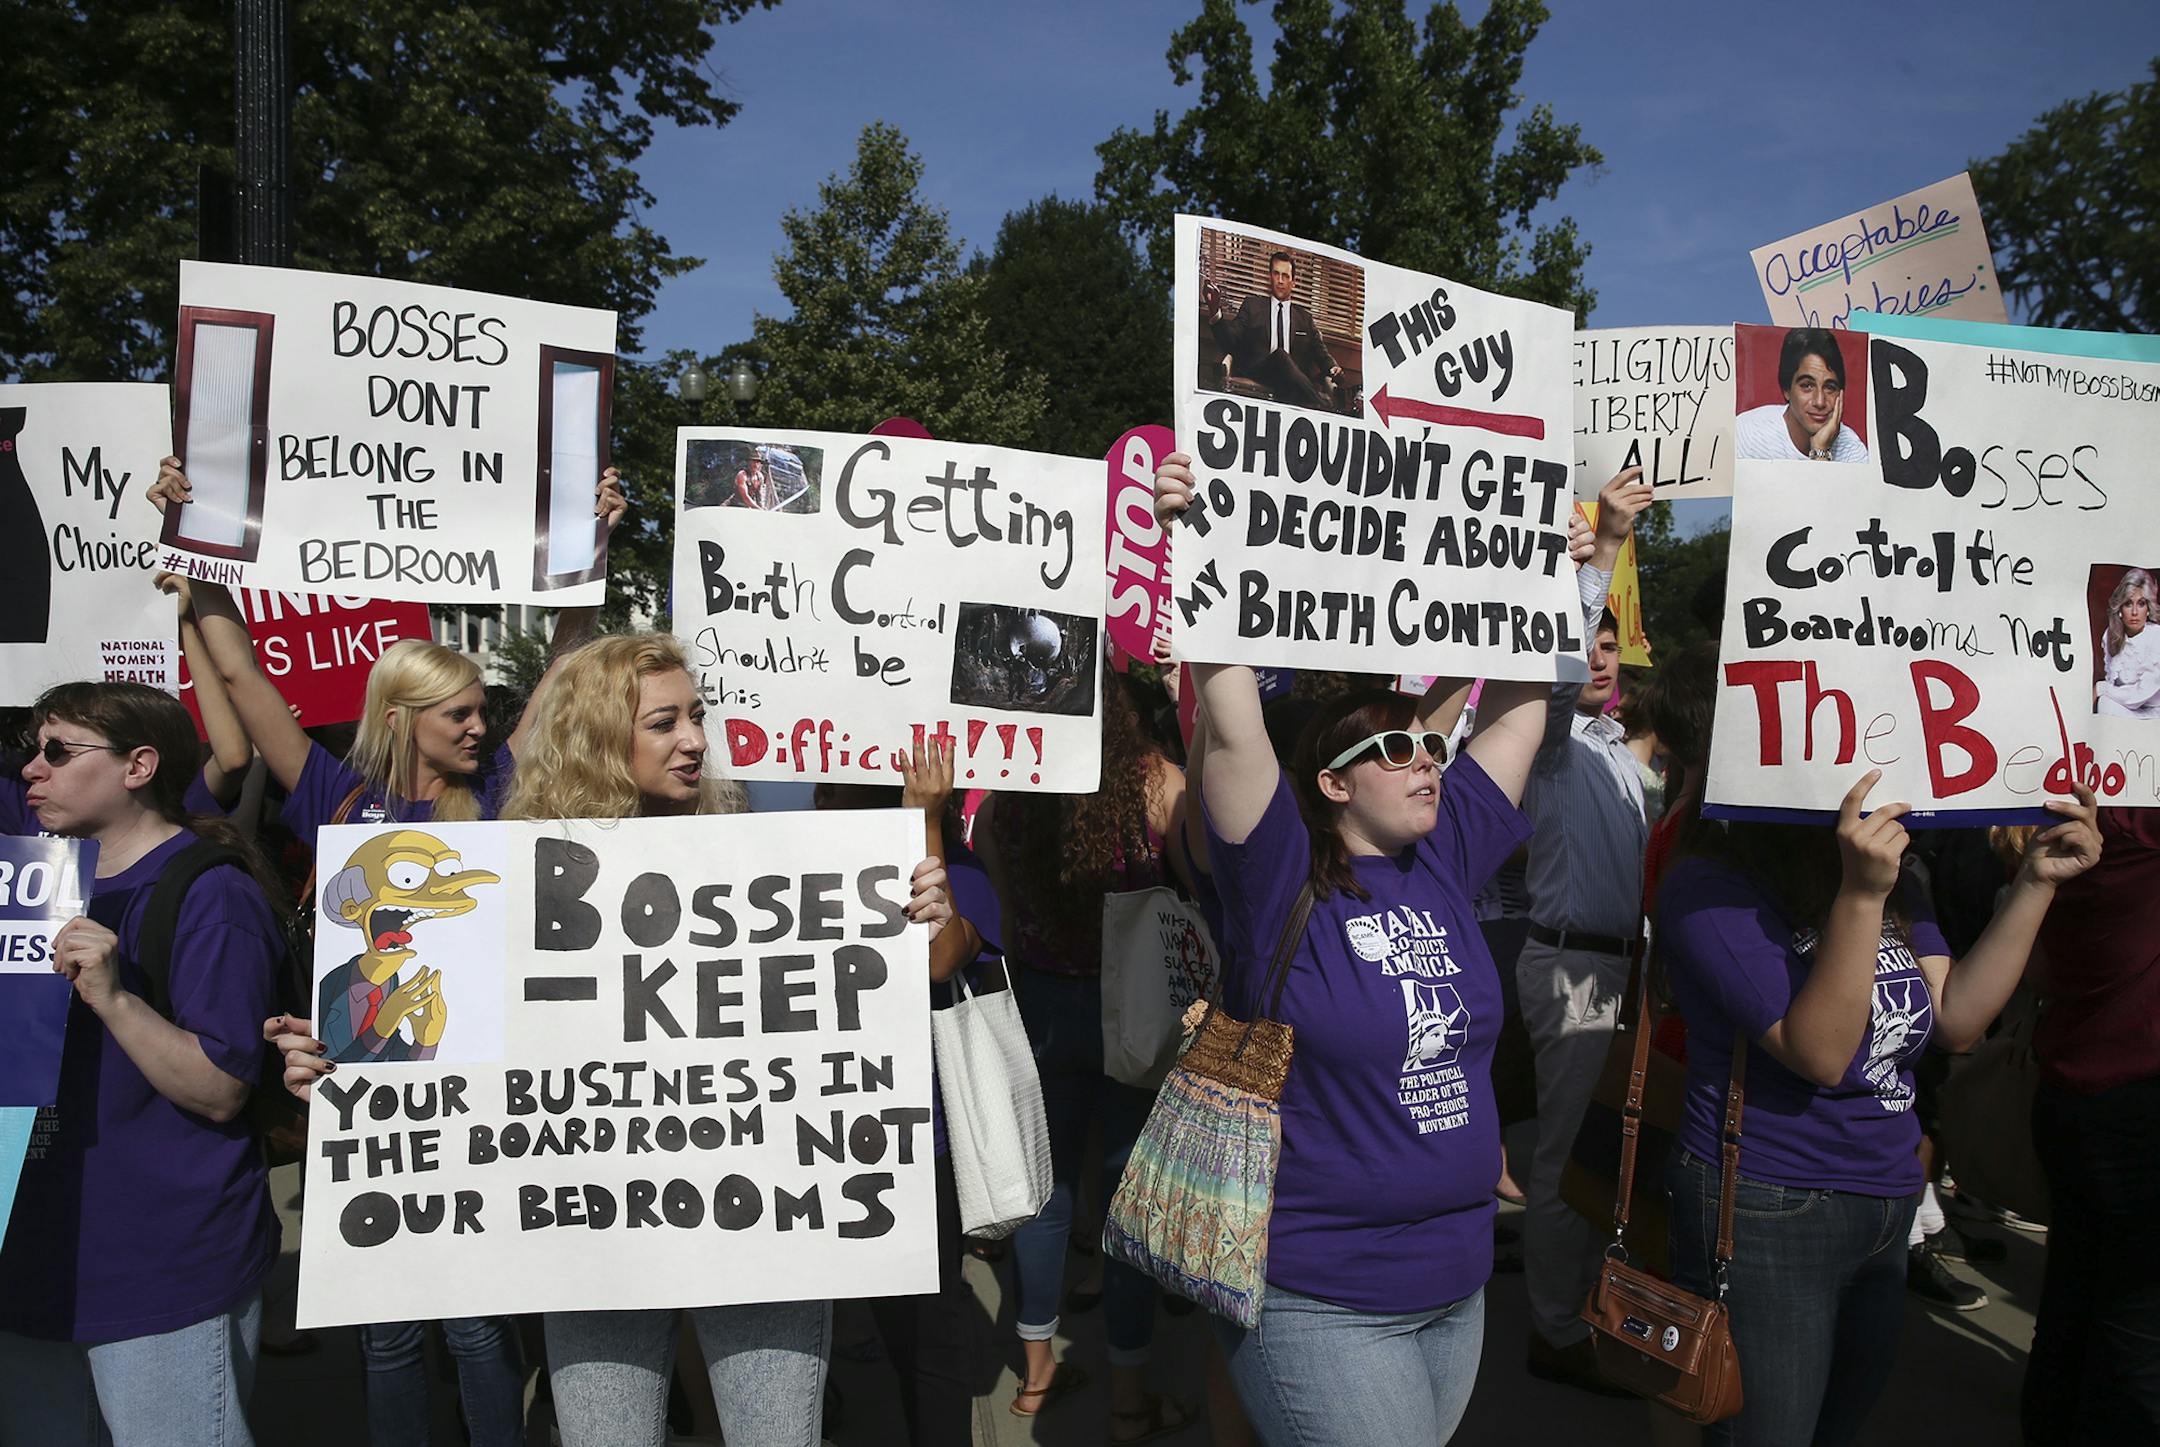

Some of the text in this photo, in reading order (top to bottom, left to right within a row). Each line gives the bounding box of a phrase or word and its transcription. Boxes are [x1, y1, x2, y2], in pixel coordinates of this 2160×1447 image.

[1766, 204, 1961, 295] acceptable
[333, 301, 508, 365] BOSSES
[1368, 288, 1456, 369] THIS
[1434, 330, 1514, 402] GUY
[368, 375, 490, 429] DONT
[1871, 338, 2107, 511] Bosses
[62, 446, 131, 519] My
[278, 435, 502, 484] BELONG IN
[1619, 435, 1719, 487] ALL!
[366, 494, 438, 530] THE
[835, 440, 1073, 589] Getting
[1462, 449, 1568, 527] GET
[53, 523, 156, 572] Choice
[1106, 435, 1163, 629] STOP
[1178, 478, 1235, 538] TO
[1246, 489, 1406, 561] DECIDE
[1424, 516, 1567, 577] ABOUT
[162, 553, 244, 585] #NWHN
[300, 539, 500, 590] BEDROOM
[698, 540, 821, 622] Birth
[1767, 518, 2034, 593] Control the
[1175, 559, 1227, 628] MY
[1239, 569, 1375, 645] BIRTH
[1388, 579, 1580, 655] CONTROL
[1743, 597, 1995, 652] Boardrooms
[101, 641, 165, 651] NATIONAL
[102, 654, 165, 665] WOMEN'S
[306, 619, 400, 671] LIKE
[854, 635, 911, 686] be
[104, 670, 166, 684] HEALTH
[700, 673, 762, 709] this
[1724, 659, 2160, 801] The Bedroom
[317, 1050, 895, 1131] YOUR BUSINESS IN
[1397, 1080, 1469, 1105] LEADER OF THE
[1400, 1066, 1464, 1090] THE POLITICAL
[1409, 1096, 1469, 1120] PRO-CHOICE
[1417, 1111, 1469, 1134] MOVEMENT
[320, 1104, 930, 1183] THE BOARDROOM NOT
[338, 1172, 896, 1248] OUR BEDROOMS
